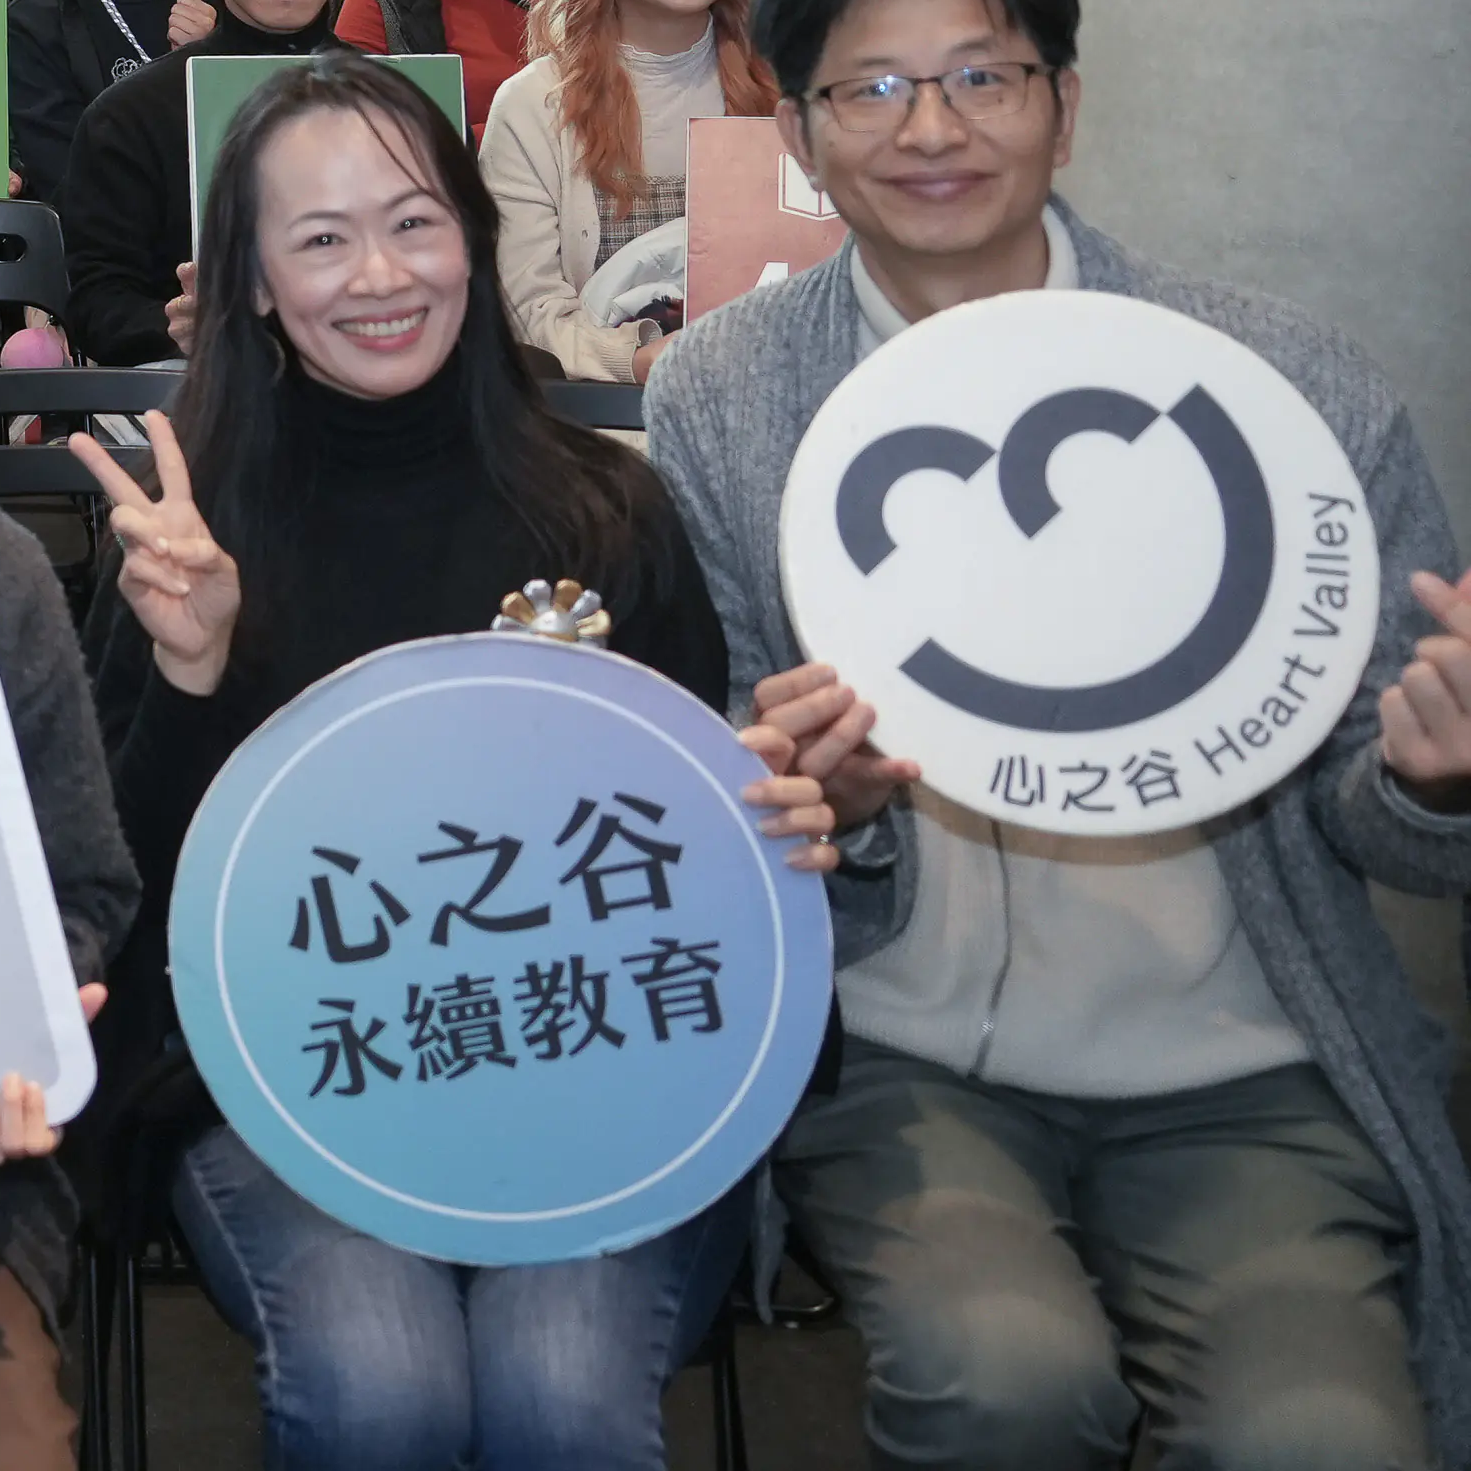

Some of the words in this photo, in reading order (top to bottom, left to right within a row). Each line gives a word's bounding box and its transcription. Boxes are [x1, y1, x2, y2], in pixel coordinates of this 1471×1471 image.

[1293, 491, 1357, 640] Valley
[989, 749, 1183, 812] 心之谷
[1193, 653, 1327, 777] Heart
[288, 791, 682, 965] 心之谷
[301, 936, 724, 1099] 永續教育
